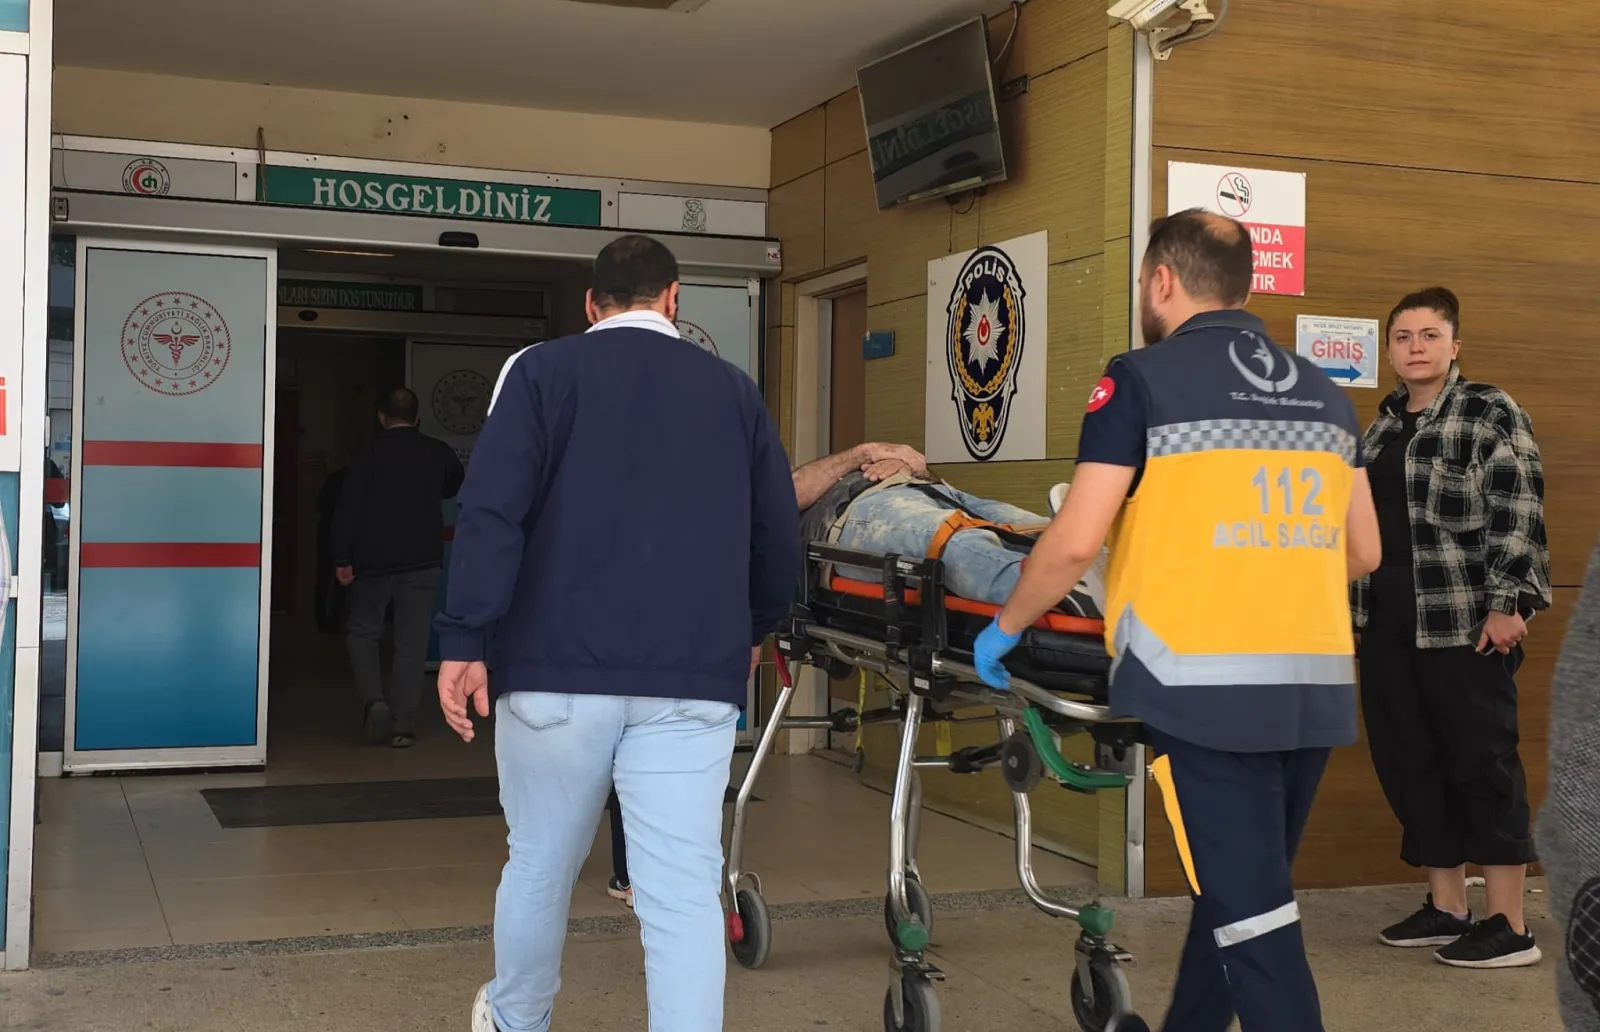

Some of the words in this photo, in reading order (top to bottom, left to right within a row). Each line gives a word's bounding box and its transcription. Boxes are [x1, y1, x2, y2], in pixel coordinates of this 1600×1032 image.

[965, 258, 1005, 291] POLİS
[141, 310, 184, 341] CUMHURİYETİ
[186, 313, 207, 334] SAĞLIK
[141, 343, 161, 372] TÜRKİYE
[191, 335, 212, 373] BAKANLIĞI
[1312, 336, 1364, 365] GİRİŞ
[1252, 465, 1324, 516] 112
[1213, 516, 1271, 548] ACİL
